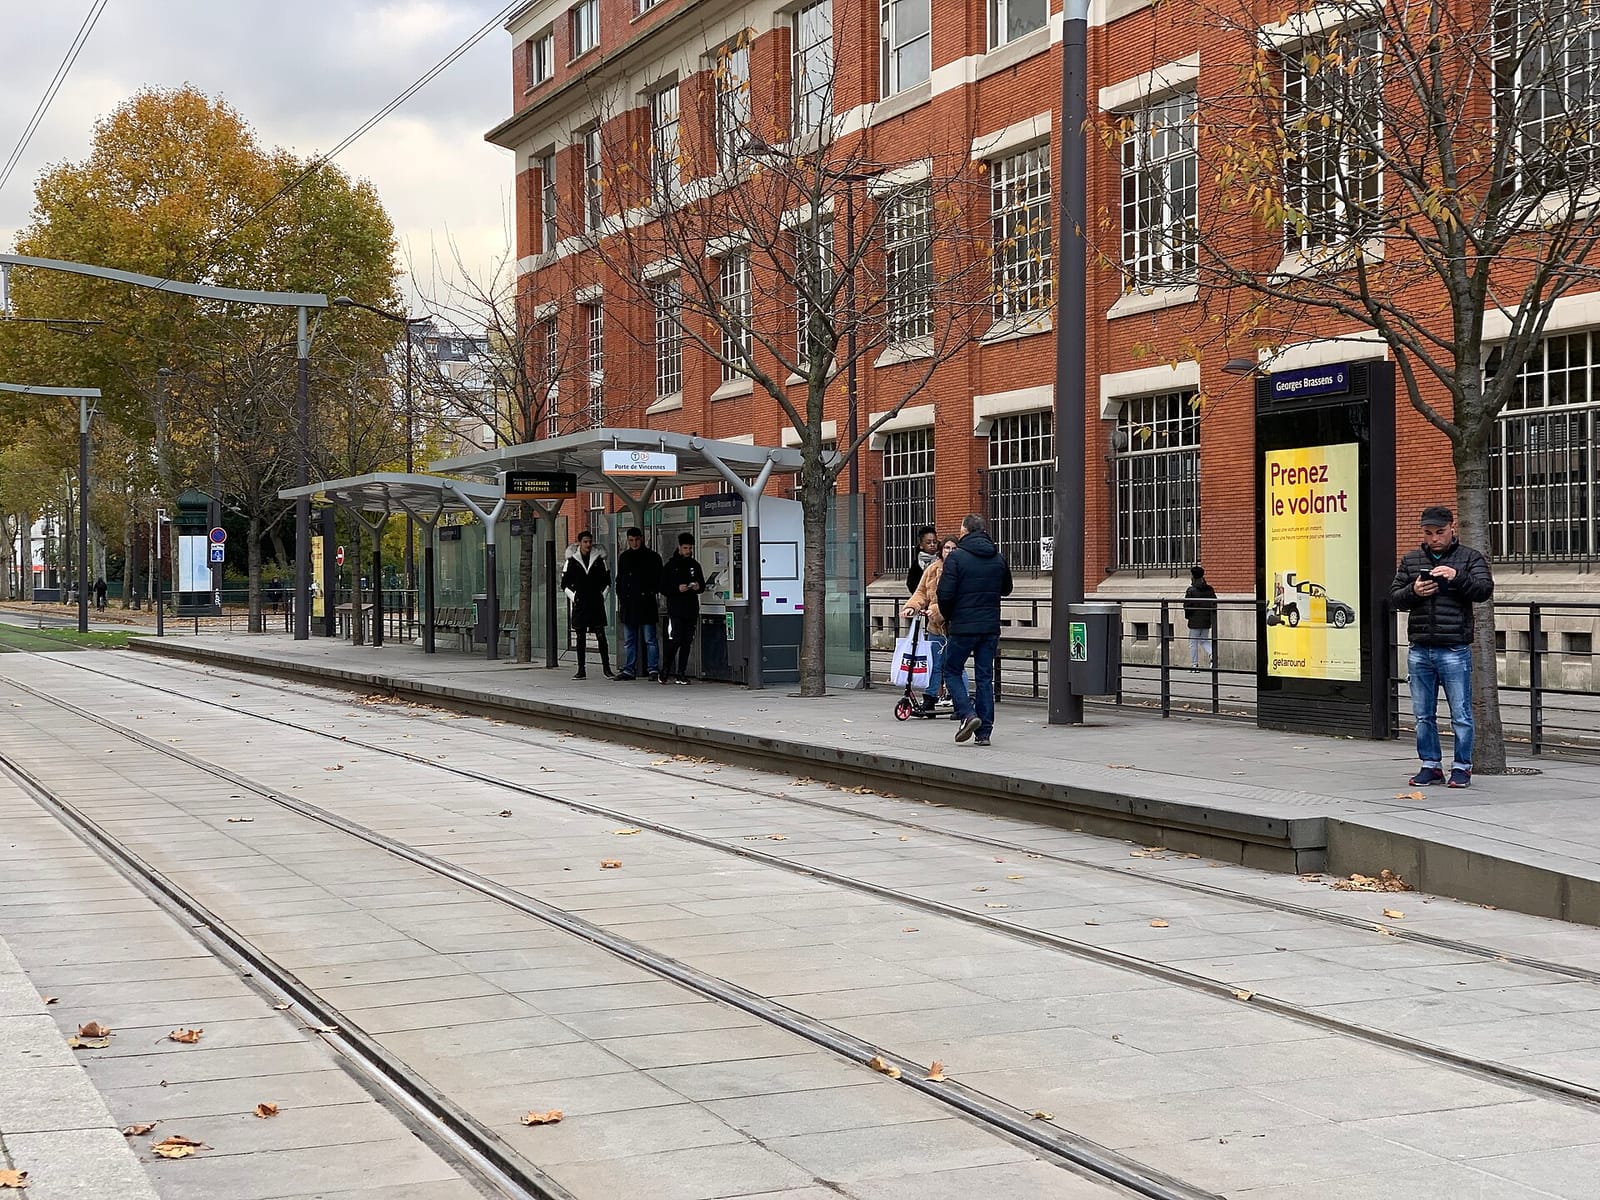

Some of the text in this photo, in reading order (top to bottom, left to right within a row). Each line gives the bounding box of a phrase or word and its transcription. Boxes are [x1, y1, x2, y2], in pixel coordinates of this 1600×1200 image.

[1276, 376, 1333, 392] Georges Brassens
[1271, 462, 1329, 486] Prenez
[1271, 489, 1348, 516] le volant
[1273, 658, 1306, 670] getaround
